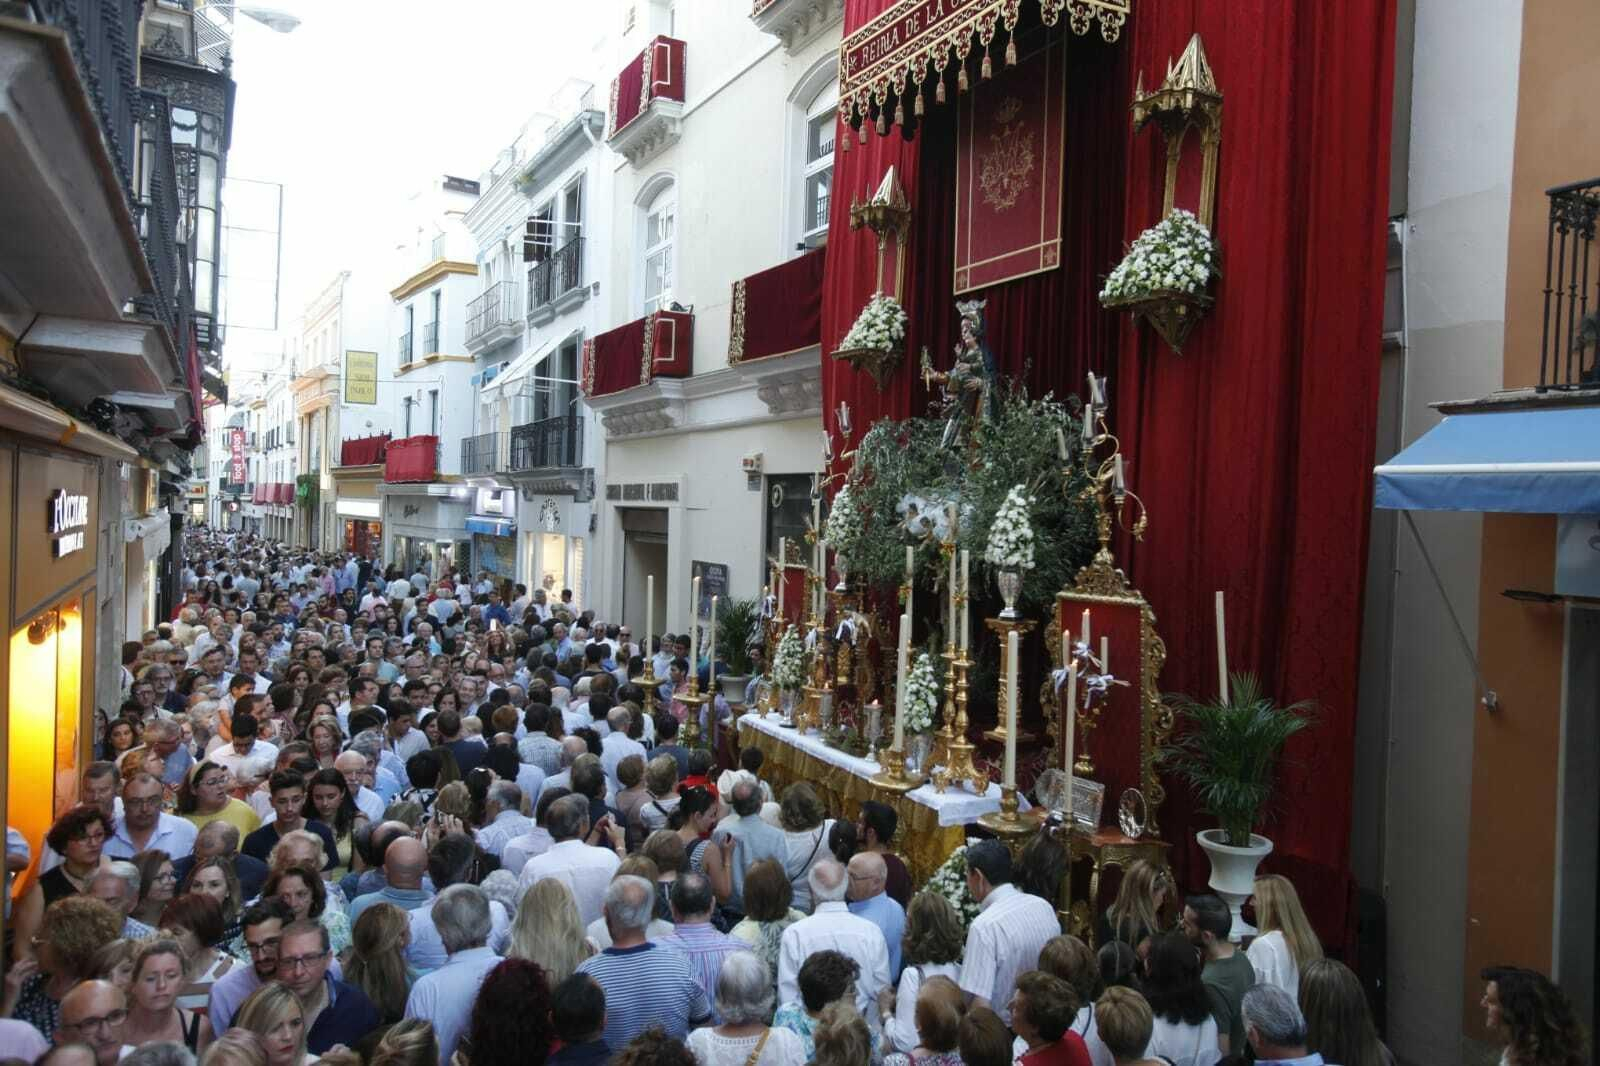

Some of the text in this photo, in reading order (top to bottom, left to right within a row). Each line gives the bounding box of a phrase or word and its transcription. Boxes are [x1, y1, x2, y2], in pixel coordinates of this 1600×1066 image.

[861, 0, 944, 67] REINA DE LA
